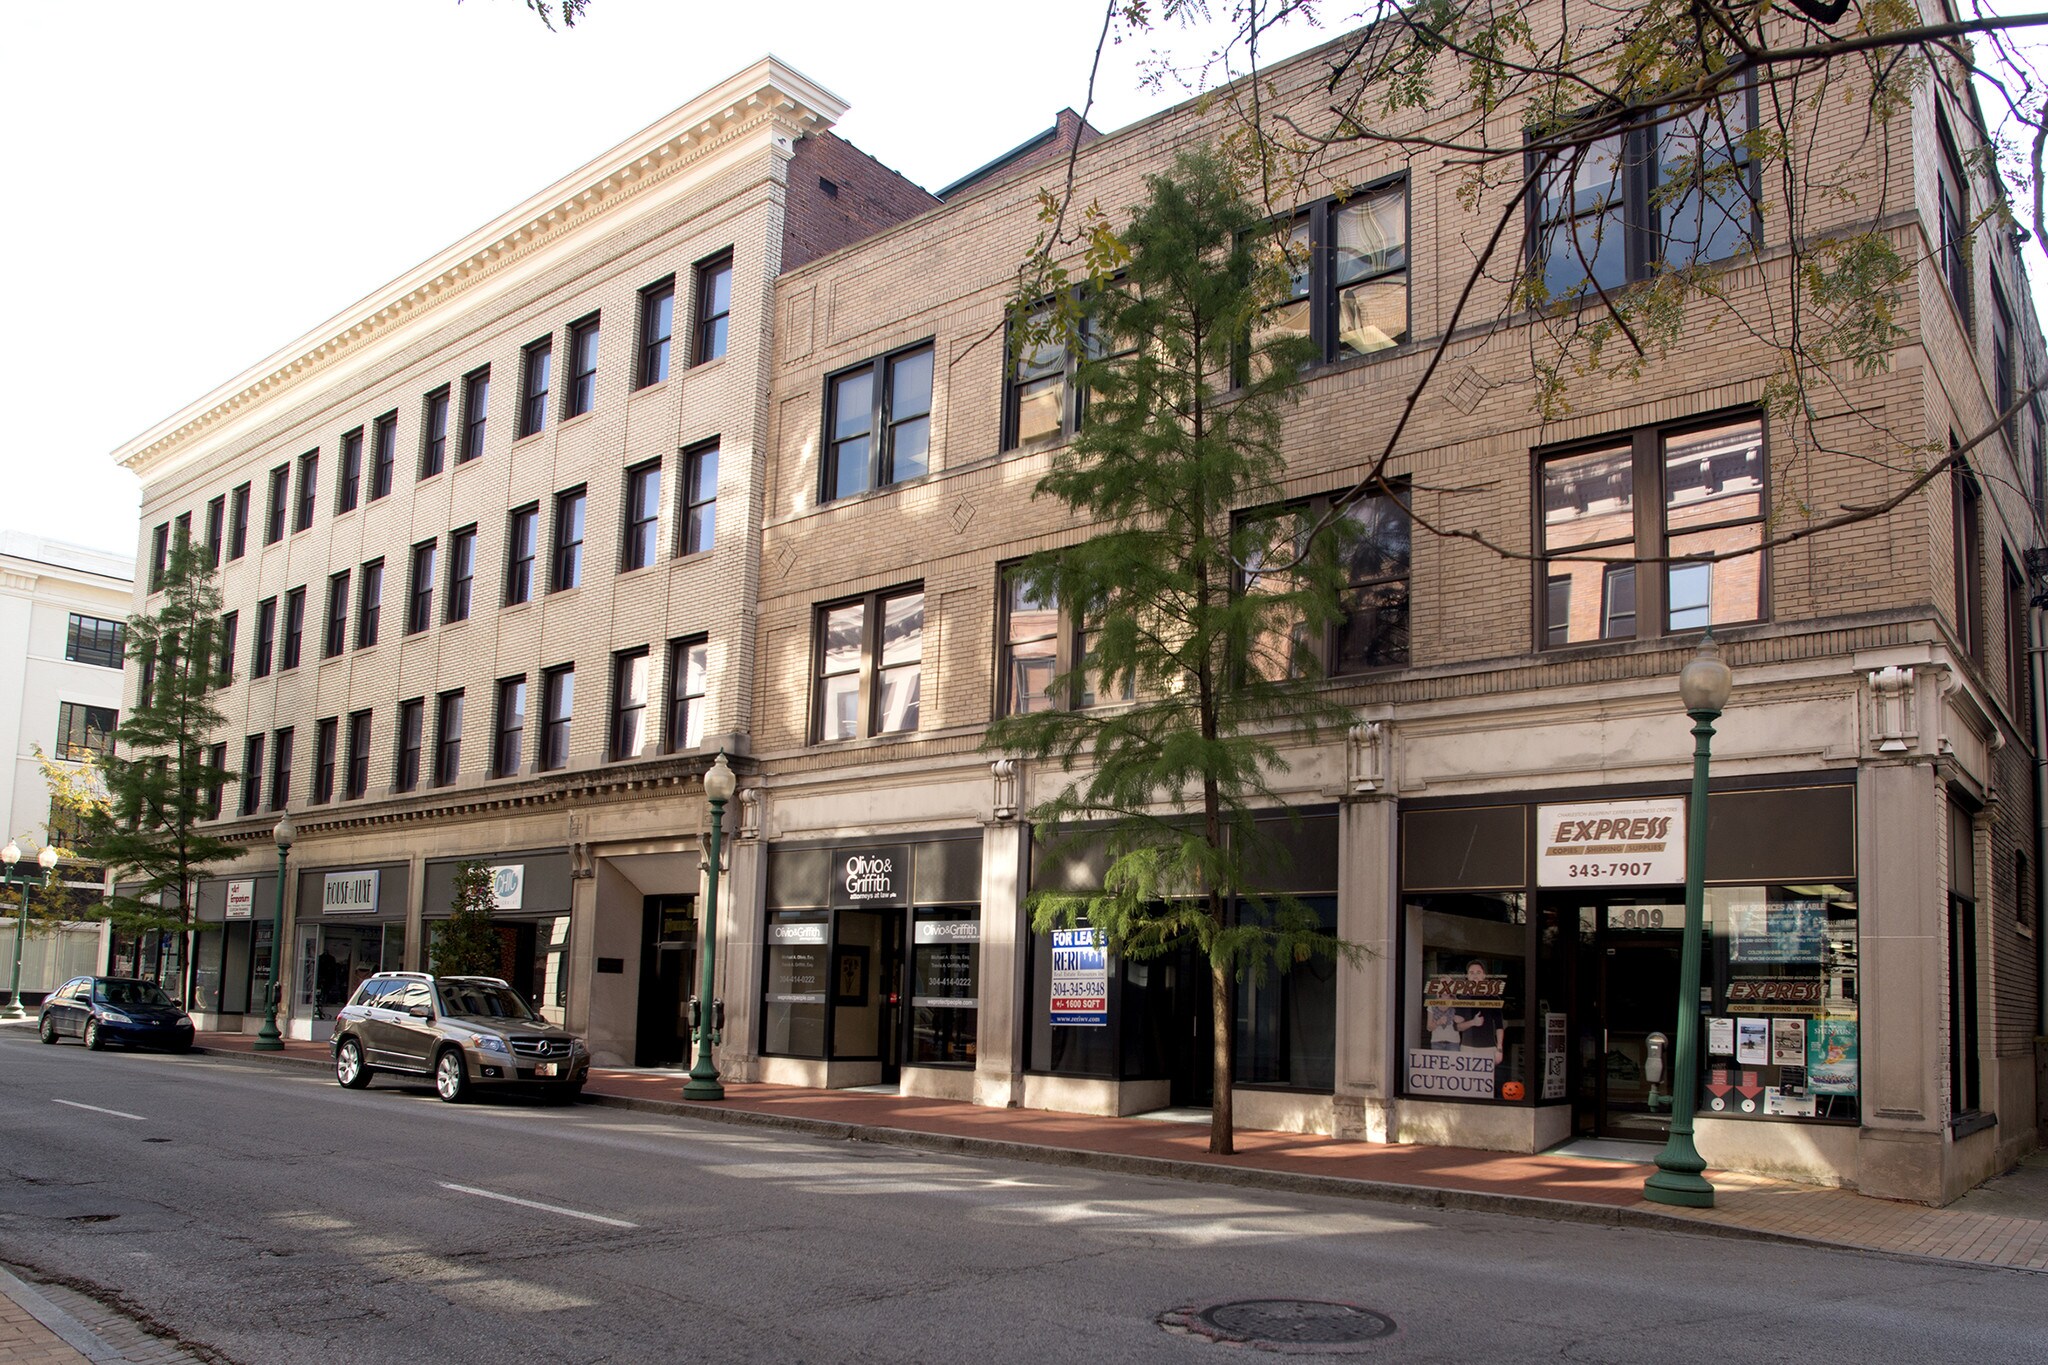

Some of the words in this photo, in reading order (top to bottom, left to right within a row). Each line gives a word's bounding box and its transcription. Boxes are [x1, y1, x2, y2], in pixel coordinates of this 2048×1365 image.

[1555, 816, 1672, 843] EXPRESS
[1587, 845, 1623, 853] SHIPPING
[1628, 844, 1662, 852] SUPPLIES
[1569, 863, 1652, 877] 343-7907
[327, 881, 349, 904] HOUSE
[355, 879, 371, 903] LUXE
[495, 872, 517, 893] CHIC
[846, 873, 891, 893] Griffith
[1786, 903, 1827, 911] AVAILABLE
[1623, 909, 1664, 929] 809
[1053, 931, 1073, 946] FOR
[1074, 930, 1105, 946] LEAE
[1054, 951, 1079, 971] RERI
[929, 978, 971, 986] 304-414-0222
[1053, 982, 1105, 996] 304-345-9348
[1427, 979, 1502, 995] EXPRESS
[1729, 982, 1824, 1000] EXPRESS
[1066, 1000, 1081, 1008] 1600
[1083, 999, 1100, 1009] SQFT
[1410, 1054, 1494, 1073] LIFE-SIZE
[1410, 1074, 1493, 1093] CUTOUTS
